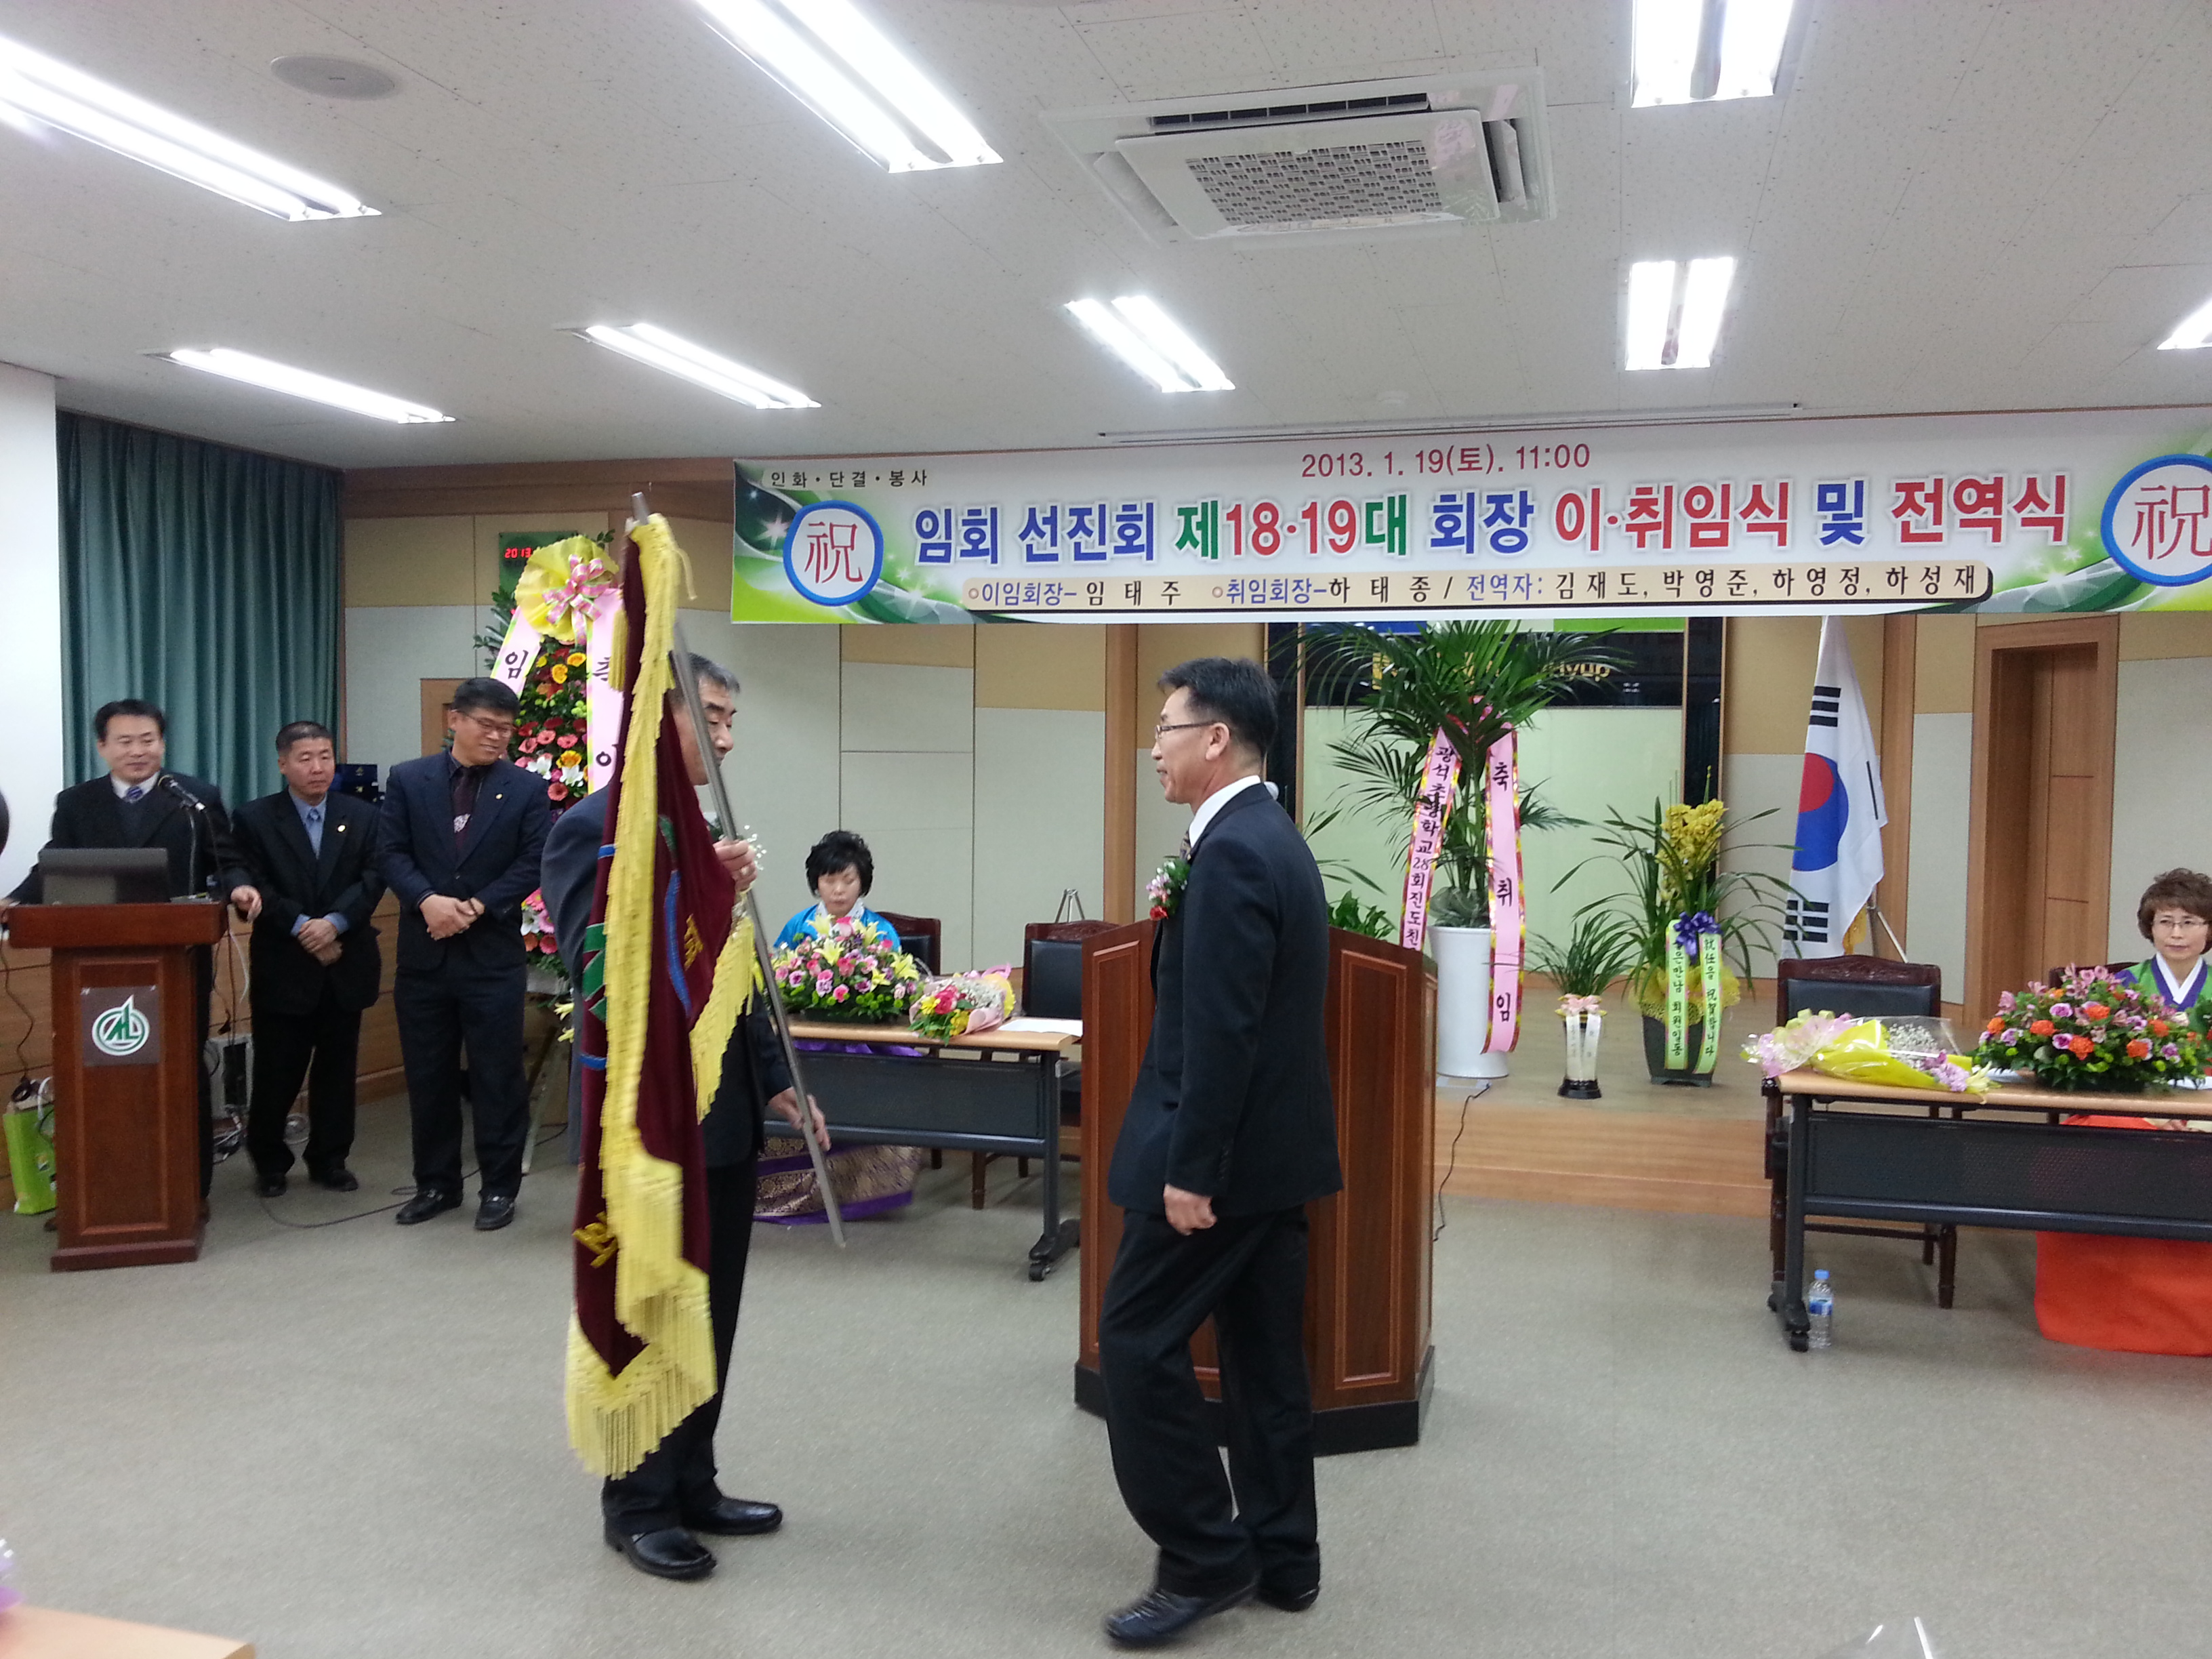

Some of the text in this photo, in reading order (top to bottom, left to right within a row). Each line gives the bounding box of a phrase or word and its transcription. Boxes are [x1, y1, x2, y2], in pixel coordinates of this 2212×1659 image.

[1302, 444, 1590, 478] 2013. 1. 19(토). 11:00
[916, 508, 998, 564] 임회
[1019, 503, 1153, 562] 선진회
[1431, 491, 1534, 554] 회장
[1817, 480, 1865, 545] 및
[1891, 475, 2066, 543] 전역식
[2131, 485, 2212, 560] 祝
[804, 520, 863, 583] 祝
[1467, 574, 1542, 601] 전역자:
